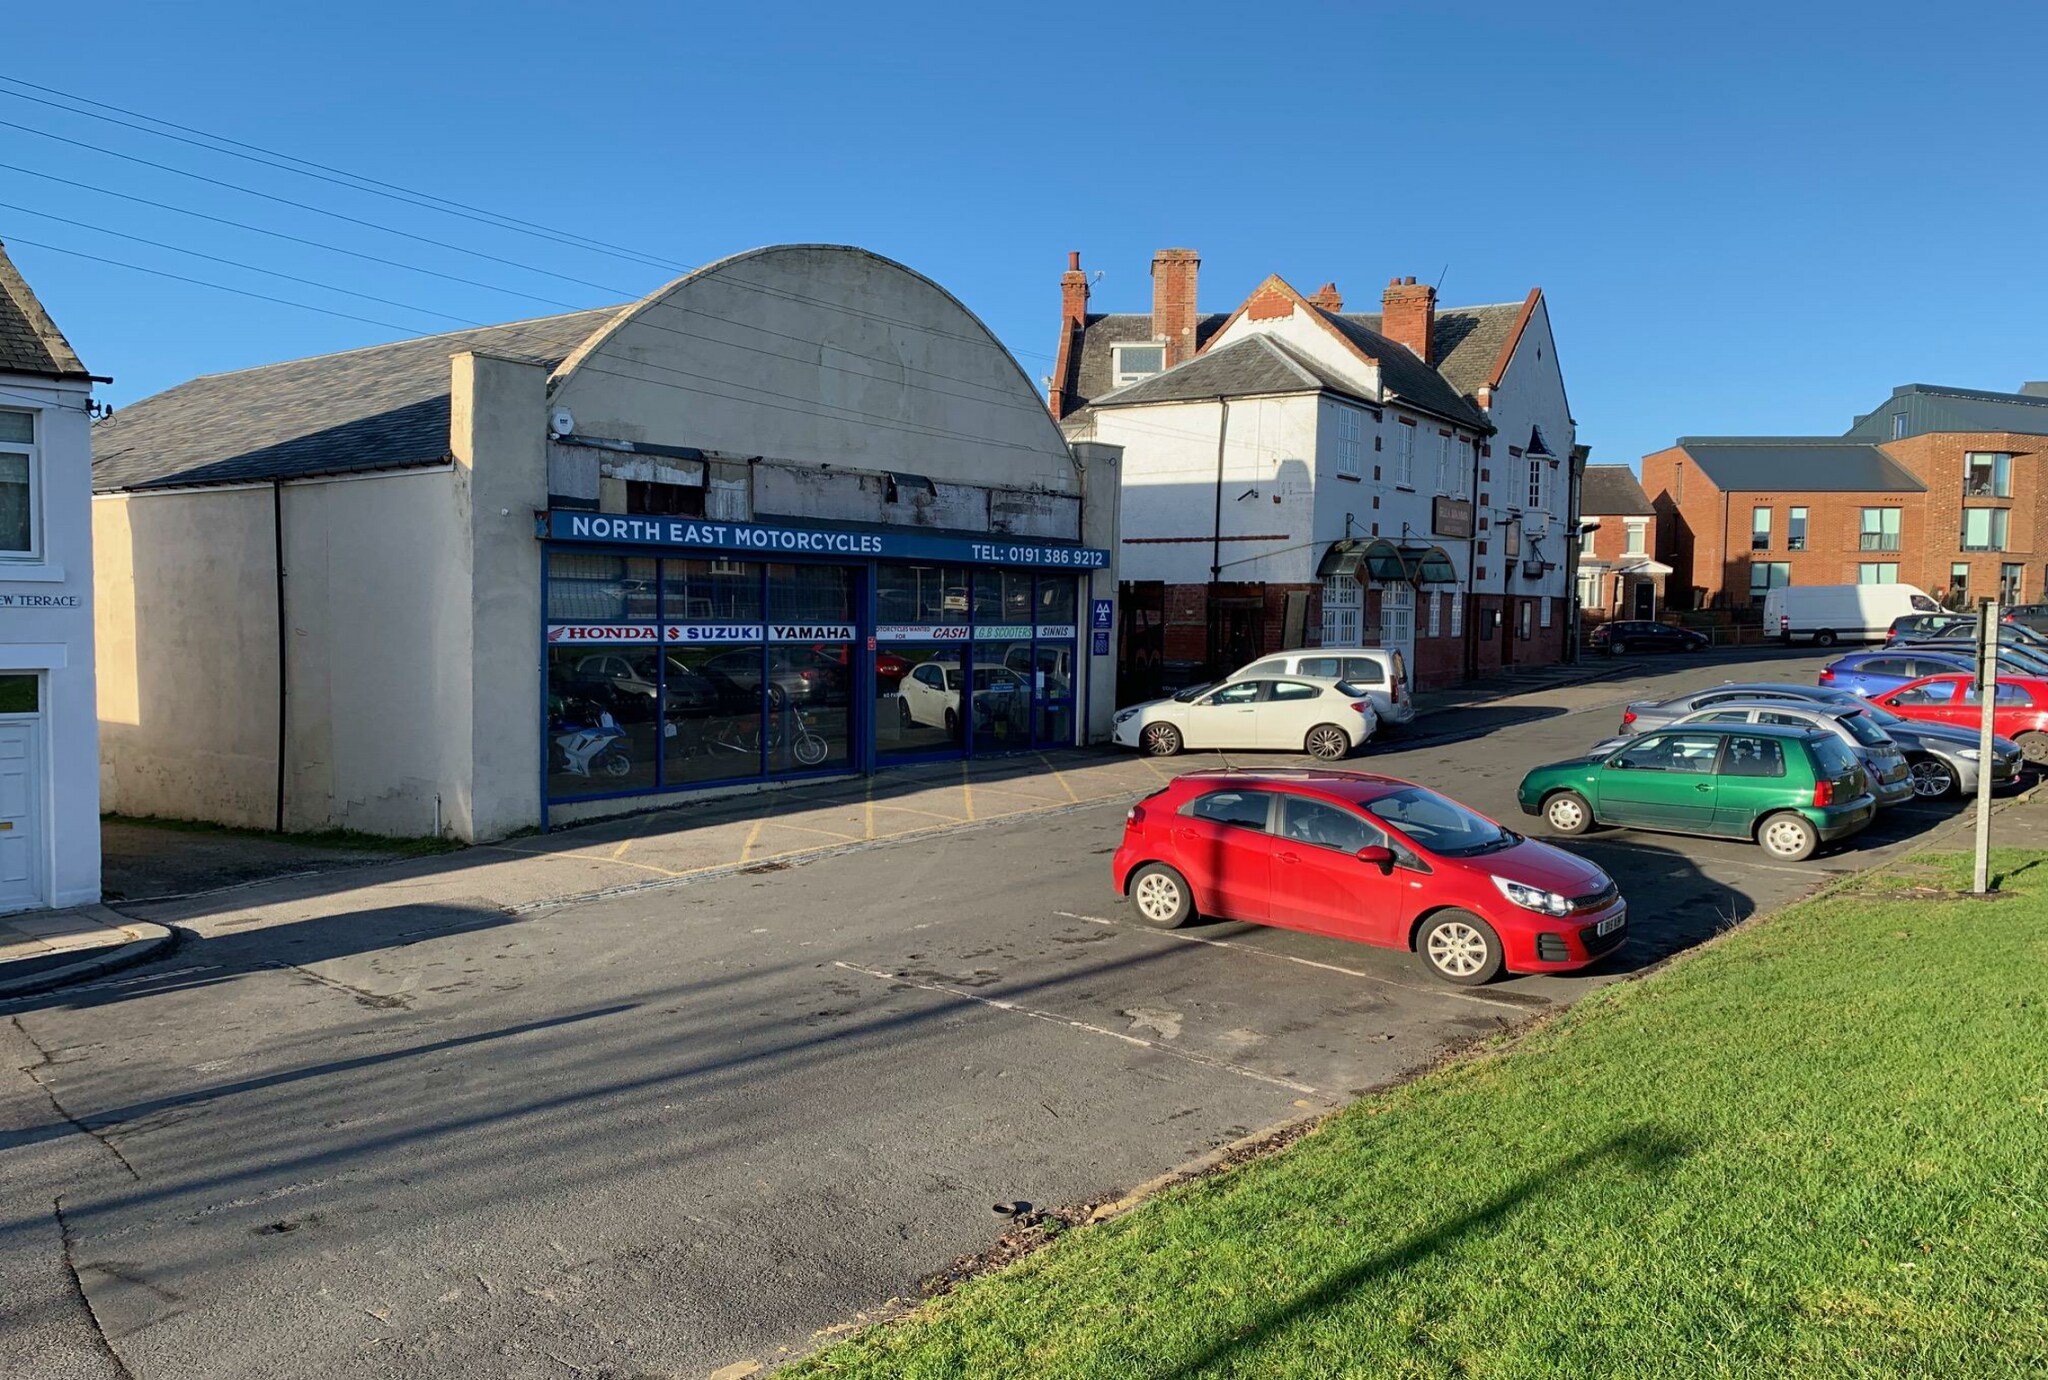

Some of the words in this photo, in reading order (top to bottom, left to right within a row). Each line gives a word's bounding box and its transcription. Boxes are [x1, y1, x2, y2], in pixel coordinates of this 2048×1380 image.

[572, 516, 660, 541] NORTH
[670, 523, 727, 544] EAST
[735, 528, 882, 552] MOTORCYCLES
[972, 545, 1004, 560] TEL:
[1009, 546, 1039, 562] 0191
[1044, 548, 1069, 564] 386
[1073, 550, 1103, 565] 9212
[19, 595, 77, 606] TERRACE
[567, 627, 658, 639] HONDA
[687, 627, 760, 640] SUZUKI
[773, 627, 851, 639] YAMAHA
[932, 627, 968, 639] CASH
[994, 627, 1032, 638] SCOOTERS
[1041, 627, 1069, 637] SINNIS
